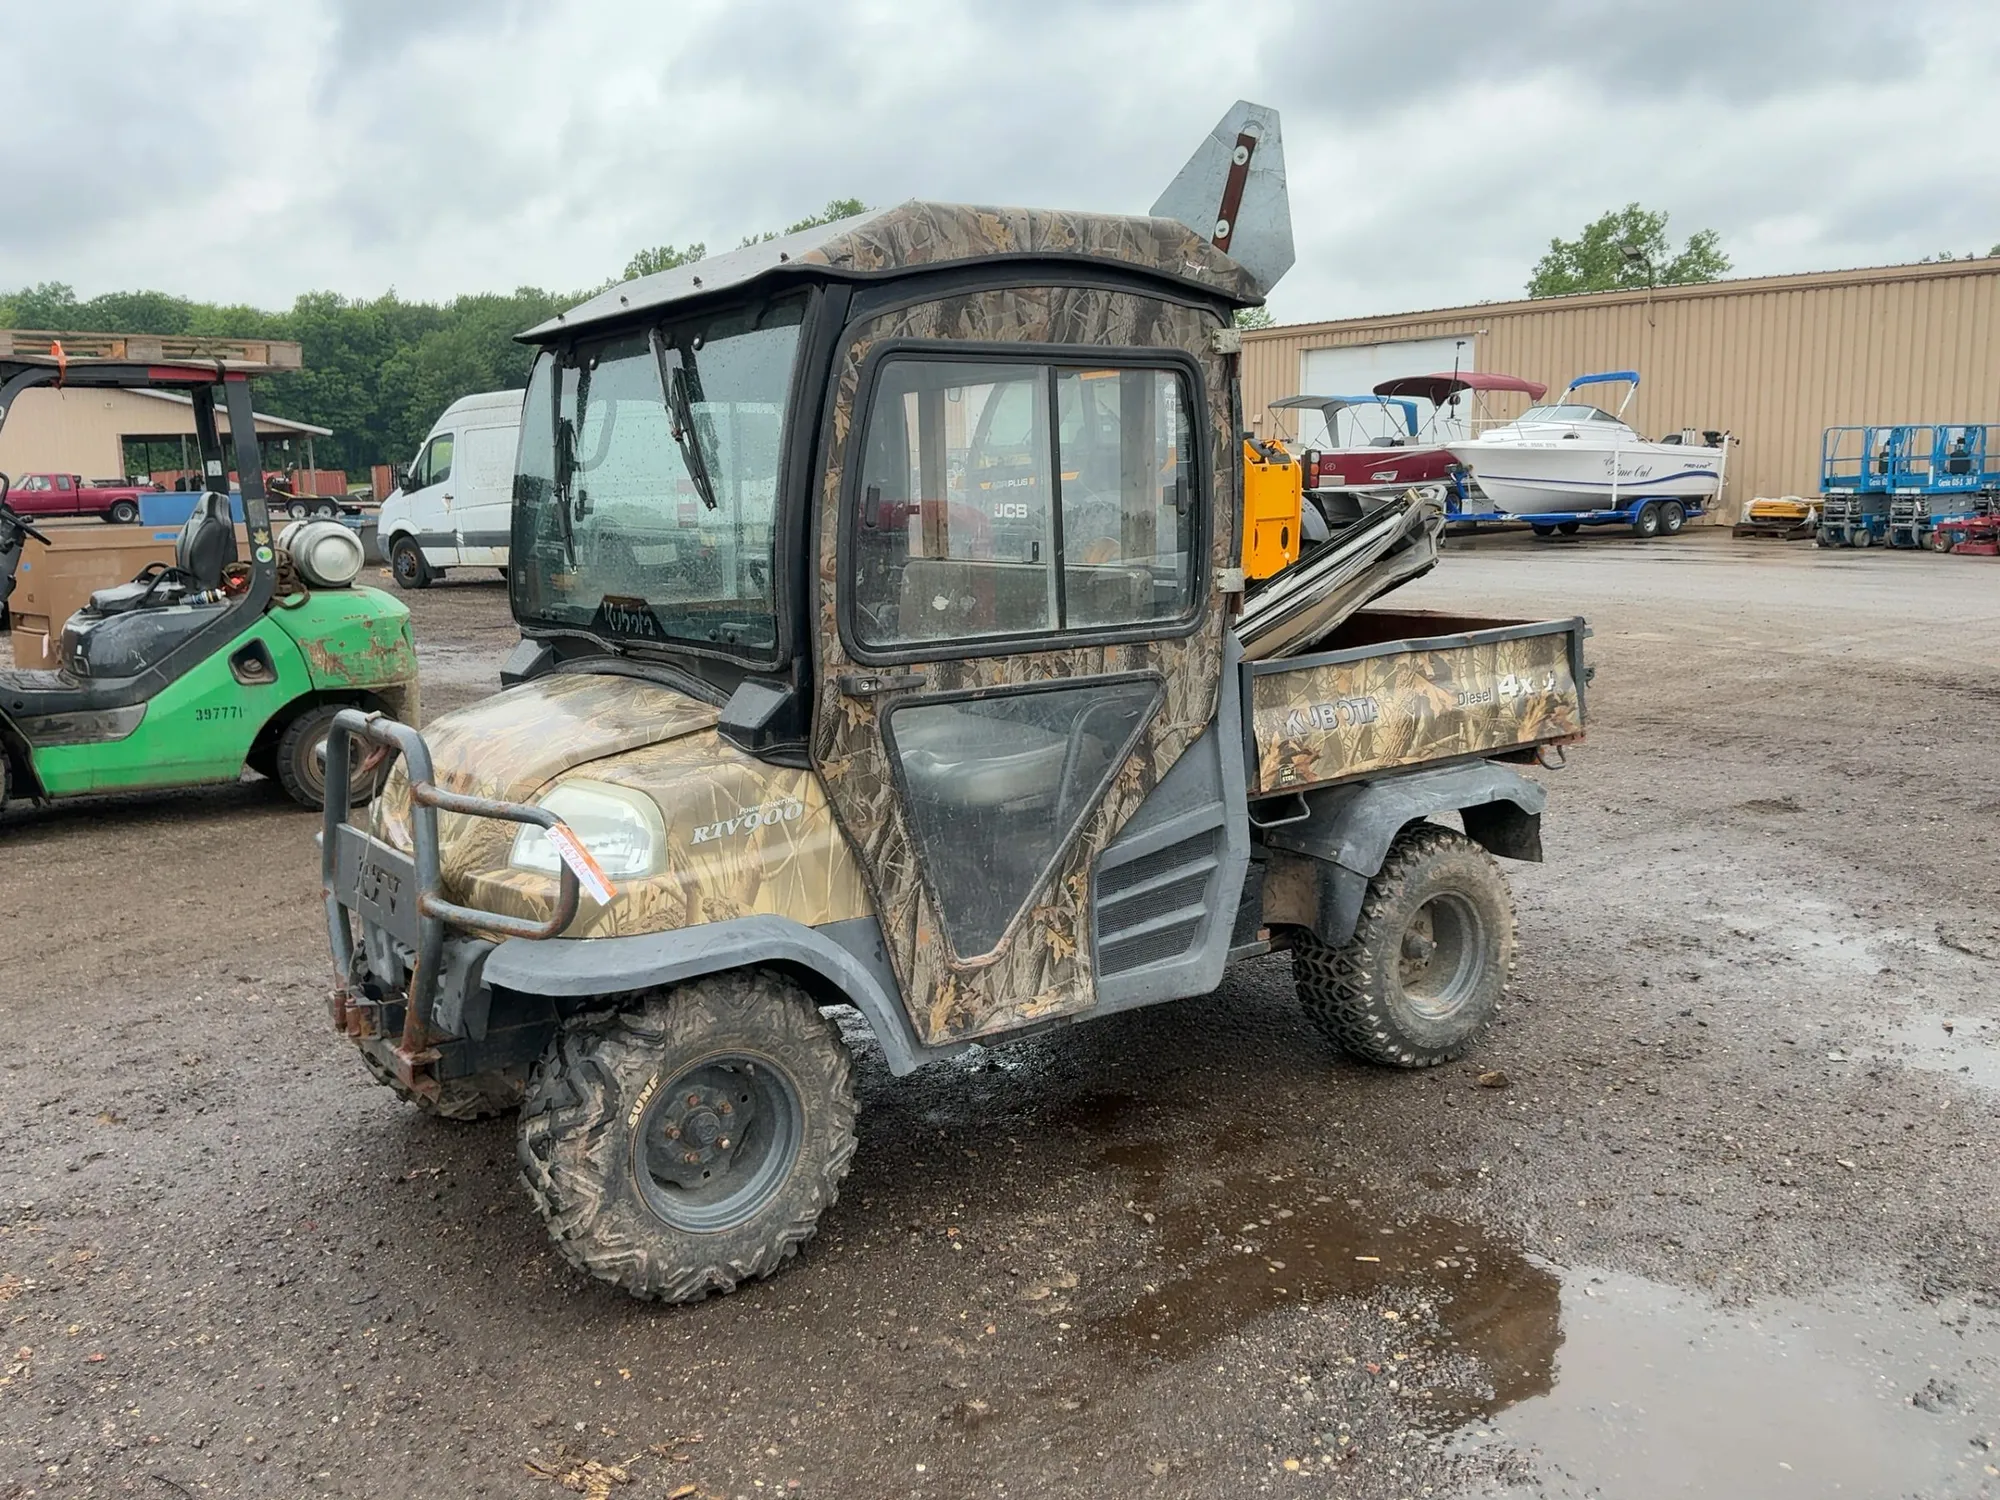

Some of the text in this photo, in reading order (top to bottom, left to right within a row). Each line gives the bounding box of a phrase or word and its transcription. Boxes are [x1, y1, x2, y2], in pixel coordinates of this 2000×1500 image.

[994, 503, 1028, 519] JCB
[1457, 687, 1492, 706] Diesel
[195, 706, 243, 721] 397771
[1284, 696, 1380, 736] KUBOTA
[739, 795, 798, 815] Power Steering
[690, 802, 803, 846] RTV900
[628, 1070, 659, 1130] SUNF
